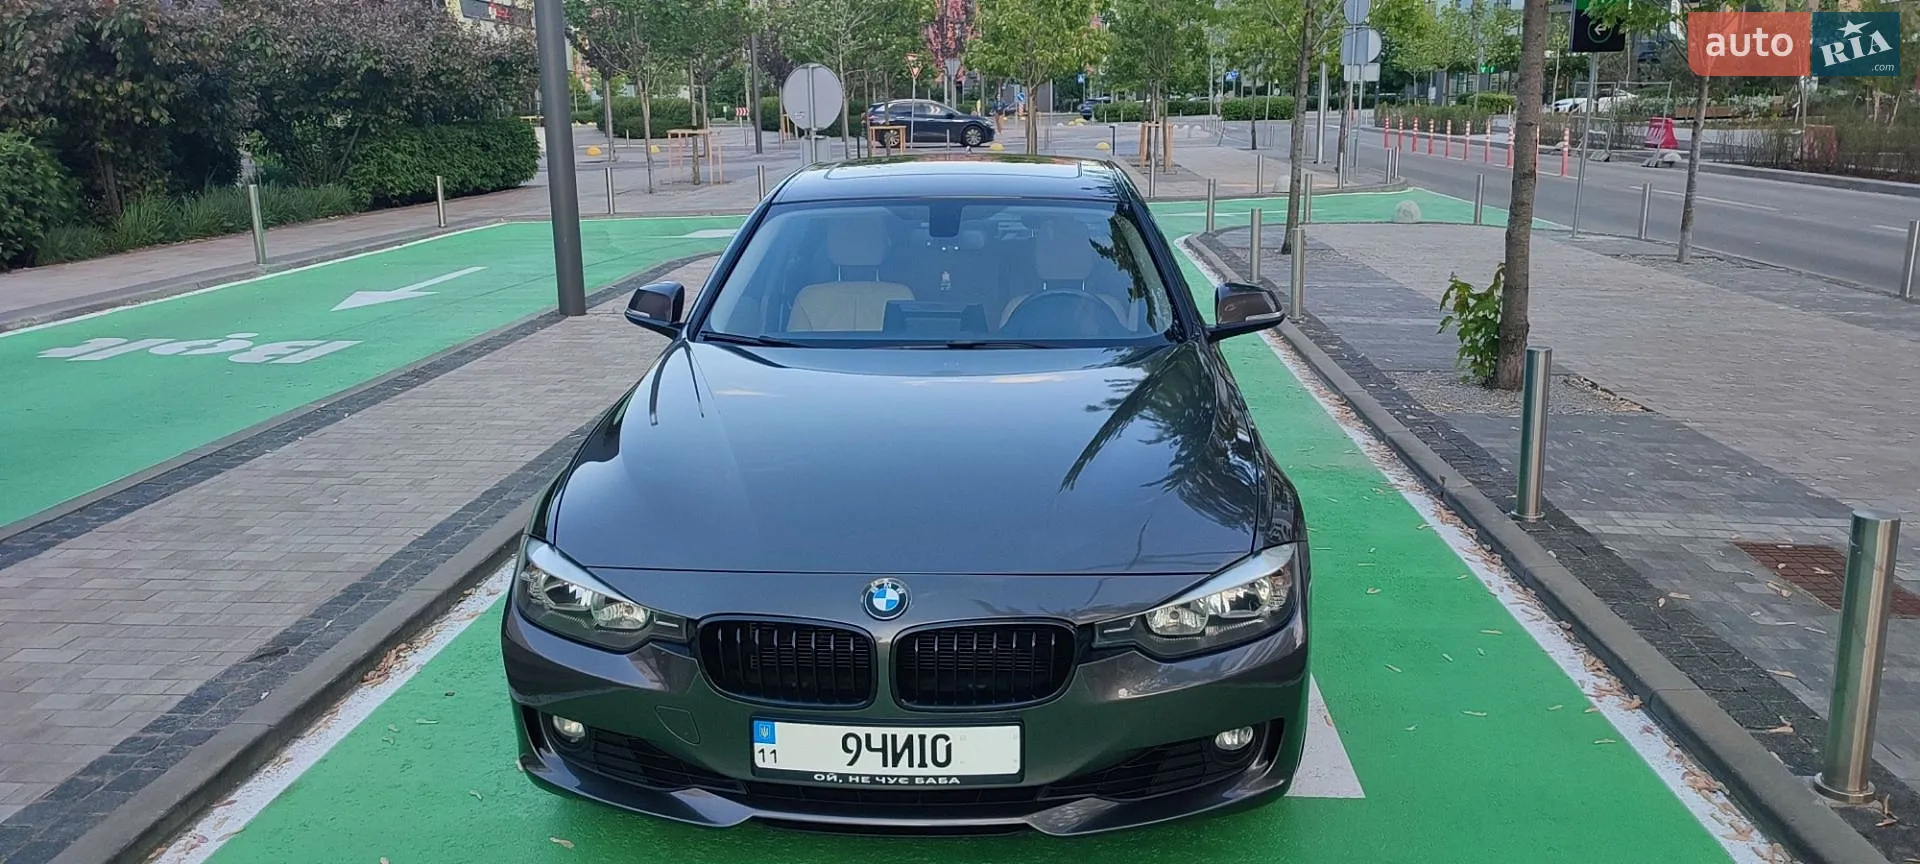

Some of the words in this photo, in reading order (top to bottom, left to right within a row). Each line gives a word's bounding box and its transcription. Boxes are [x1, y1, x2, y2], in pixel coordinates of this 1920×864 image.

[757, 748, 777, 764] 11
[813, 773, 843, 784] ОЙ,
[848, 776, 871, 784] НЕ
[914, 777, 961, 785] БАБА
